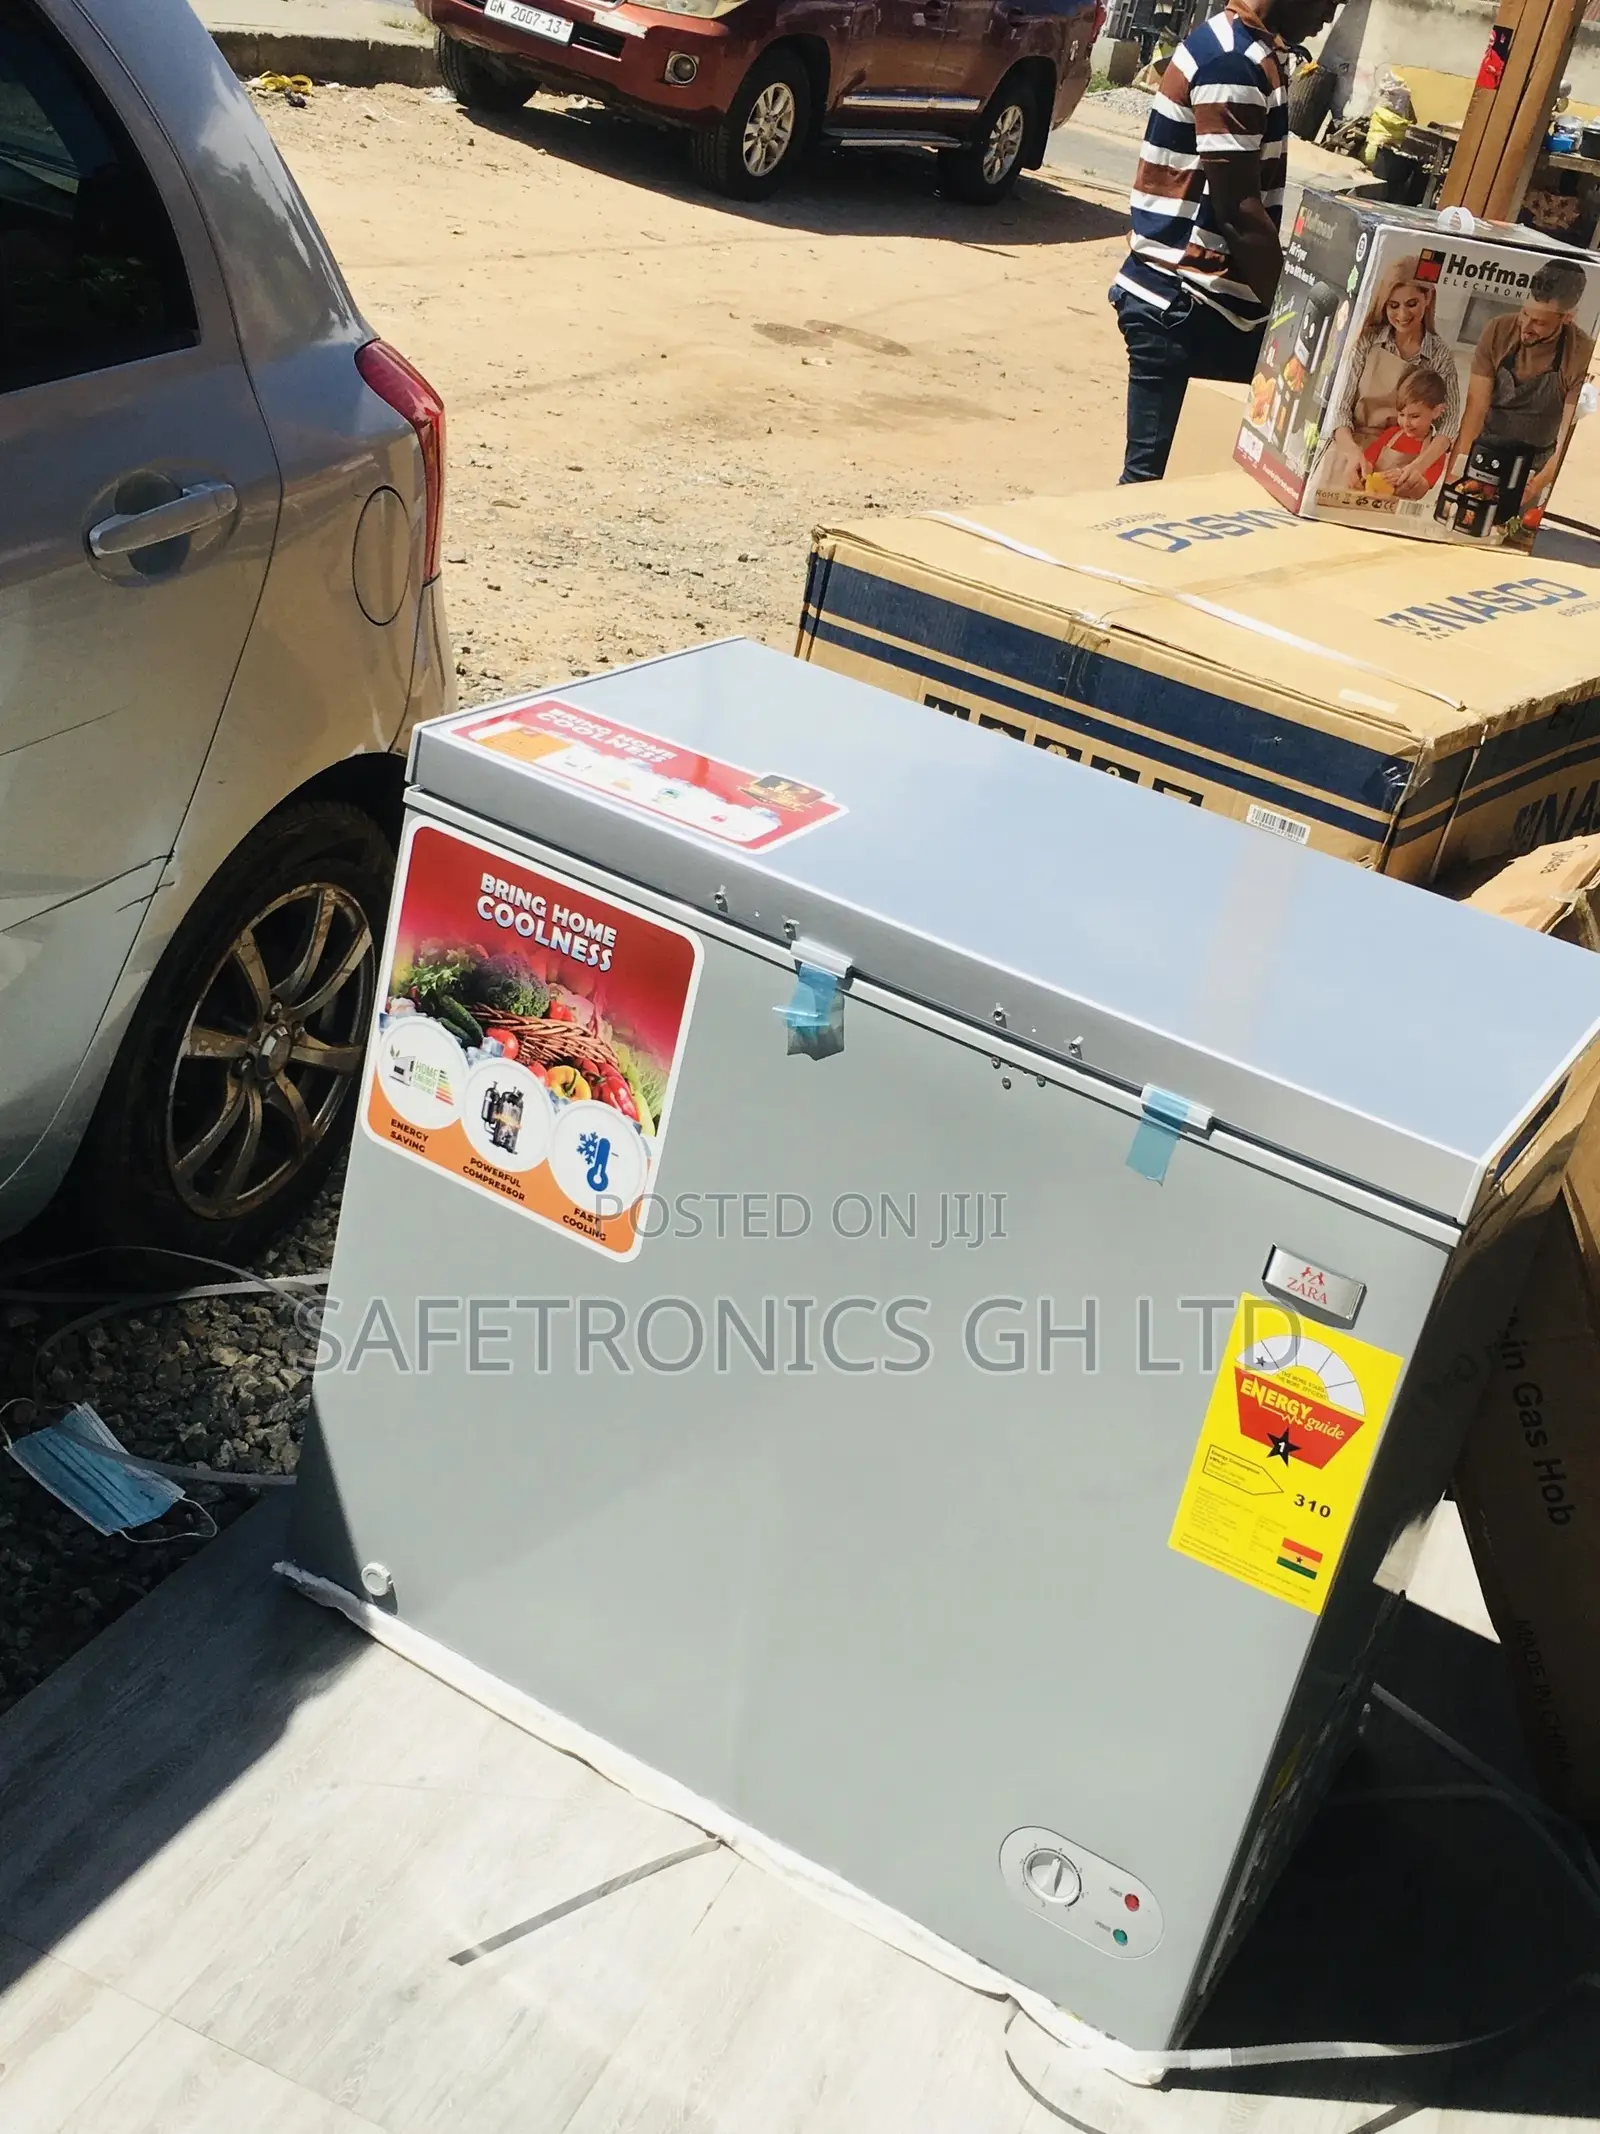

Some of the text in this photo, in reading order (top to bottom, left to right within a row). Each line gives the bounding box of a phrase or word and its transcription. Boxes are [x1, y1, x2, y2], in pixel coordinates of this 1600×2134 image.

[1404, 577, 1588, 631] NASCO
[548, 708, 612, 736] BRING
[480, 872, 617, 948] BRING HOME
[476, 895, 613, 972] COOLNESS
[390, 1131, 426, 1153] SAVING
[391, 1118, 429, 1142] ENERGY
[462, 1165, 526, 1201] COMPRESSOR
[470, 1157, 522, 1188] POWERFUL
[562, 1215, 607, 1241] COOLING
[573, 1207, 601, 1225] FAST
[1287, 1277, 1327, 1304] ZARA
[1240, 1377, 1345, 1440] ENERGY guide
[1278, 1441, 1286, 1453] 1
[1512, 1381, 1548, 1448] Gas
[1533, 1458, 1576, 1526] Hob
[1294, 1493, 1331, 1518] 310
[1514, 1620, 1574, 1774] MADE IN CHINA
